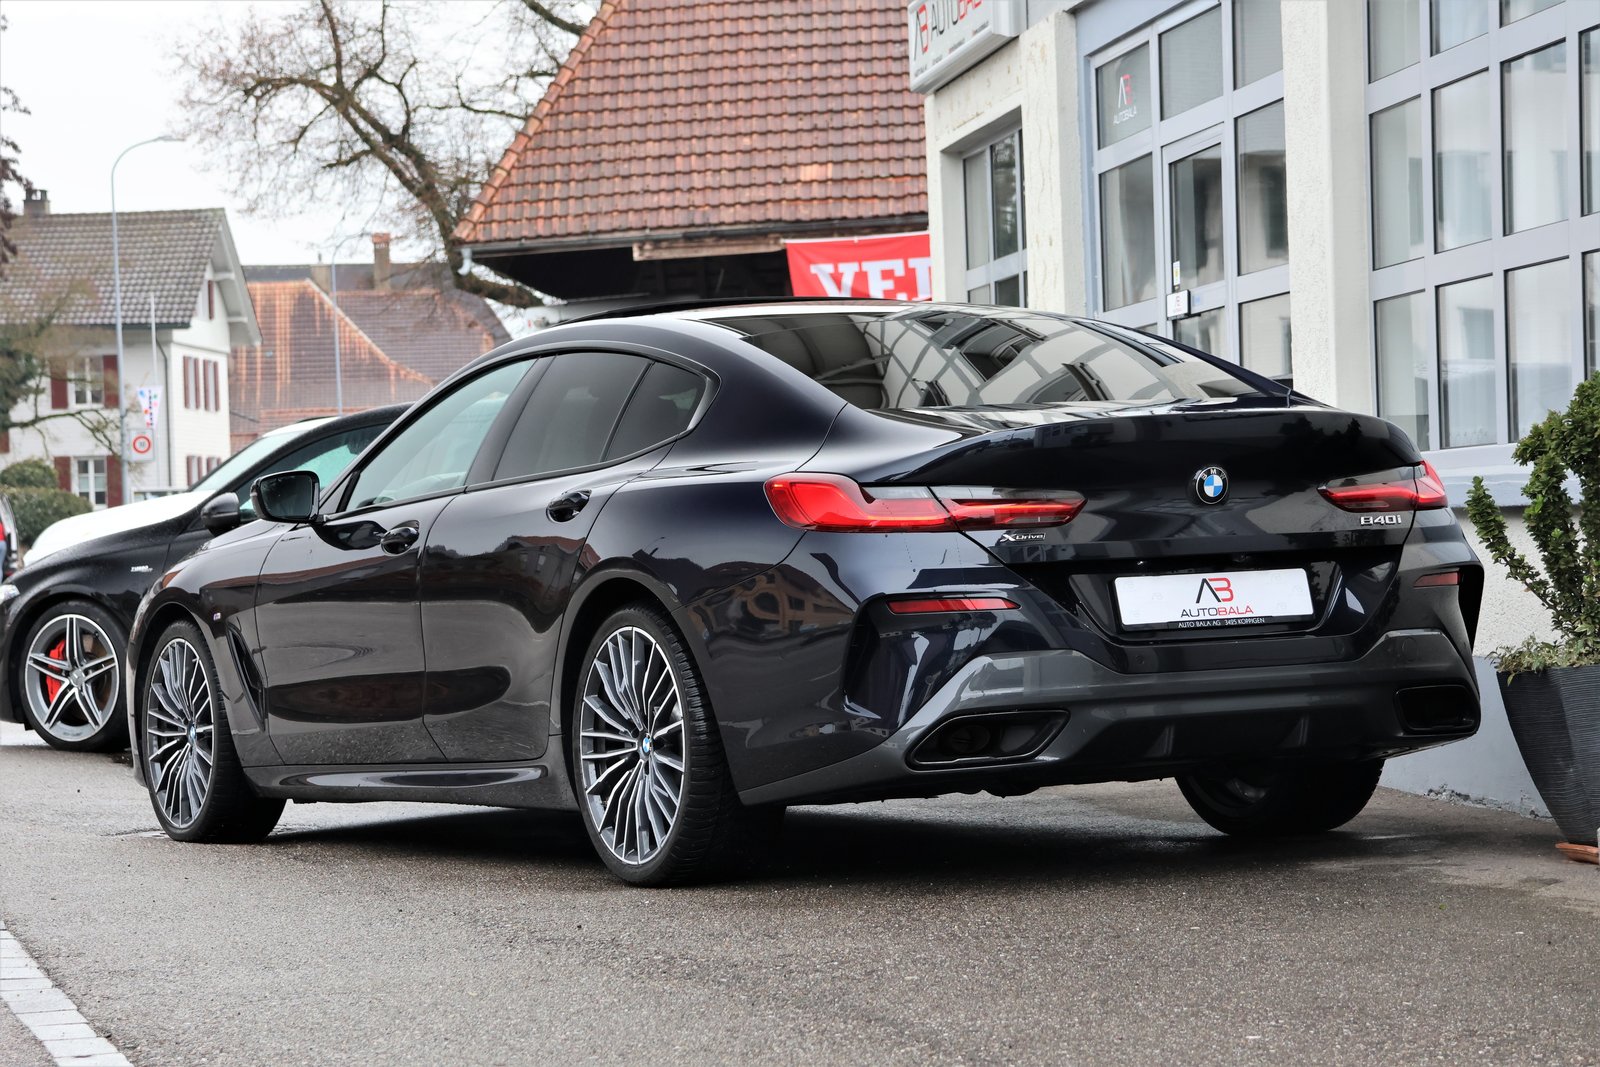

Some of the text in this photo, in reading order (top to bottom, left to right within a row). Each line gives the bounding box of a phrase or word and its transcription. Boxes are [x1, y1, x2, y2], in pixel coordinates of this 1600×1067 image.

[931, 0, 983, 41] AUTOB
[1195, 577, 1234, 604] AB
[1180, 605, 1255, 618] AUTOBALA
[1196, 620, 1211, 628] BALA
[1212, 619, 1221, 627] AG
